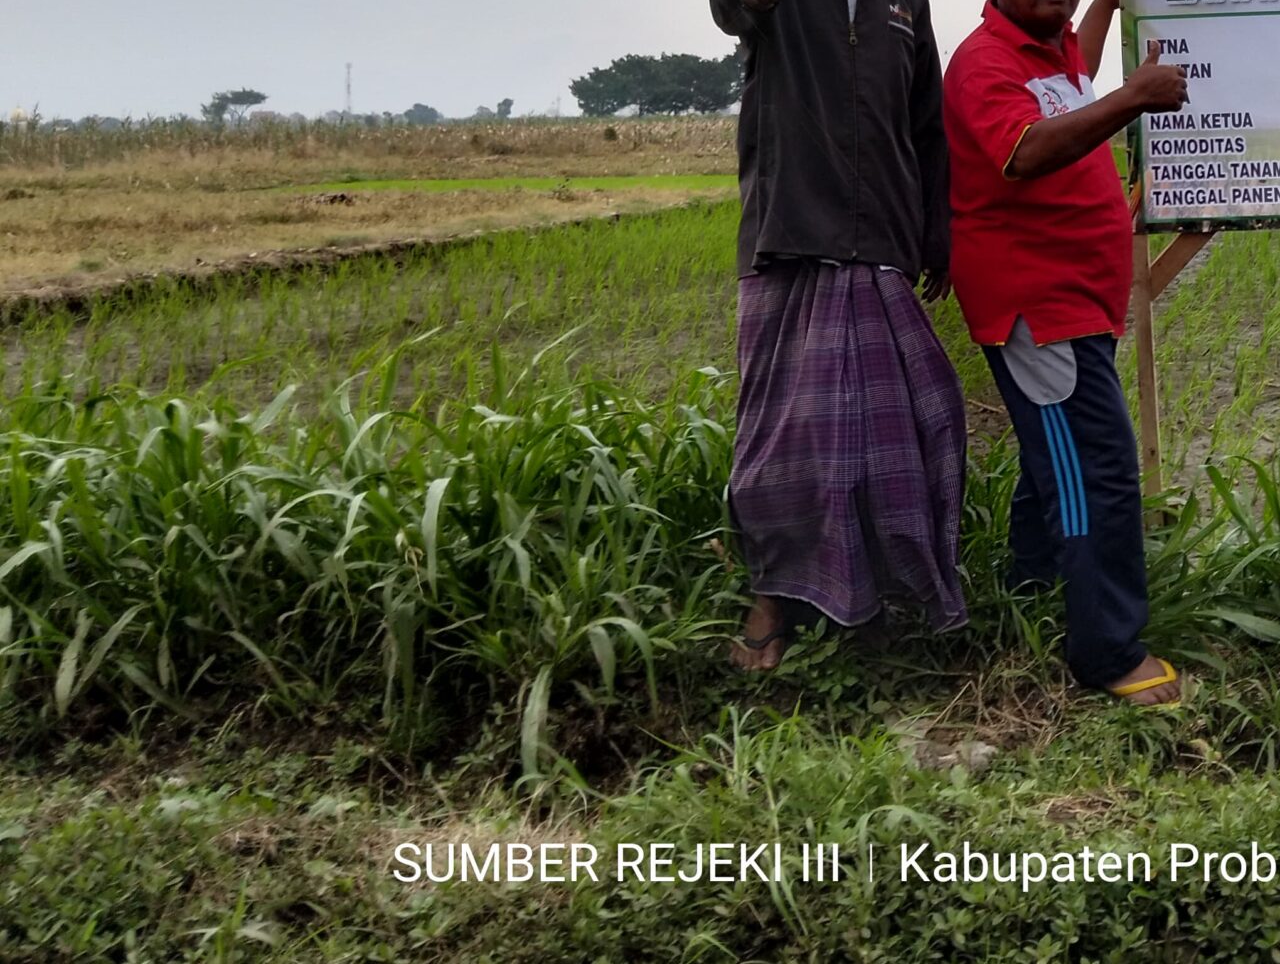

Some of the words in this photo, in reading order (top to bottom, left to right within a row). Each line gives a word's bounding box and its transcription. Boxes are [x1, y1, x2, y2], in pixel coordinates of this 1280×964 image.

[1150, 114, 1196, 130] NAMA
[1200, 112, 1253, 128] KETUA
[1151, 137, 1245, 155] KOMODITAS
[1151, 163, 1226, 180] TANGGAL
[1152, 189, 1227, 205] TANGGAL
